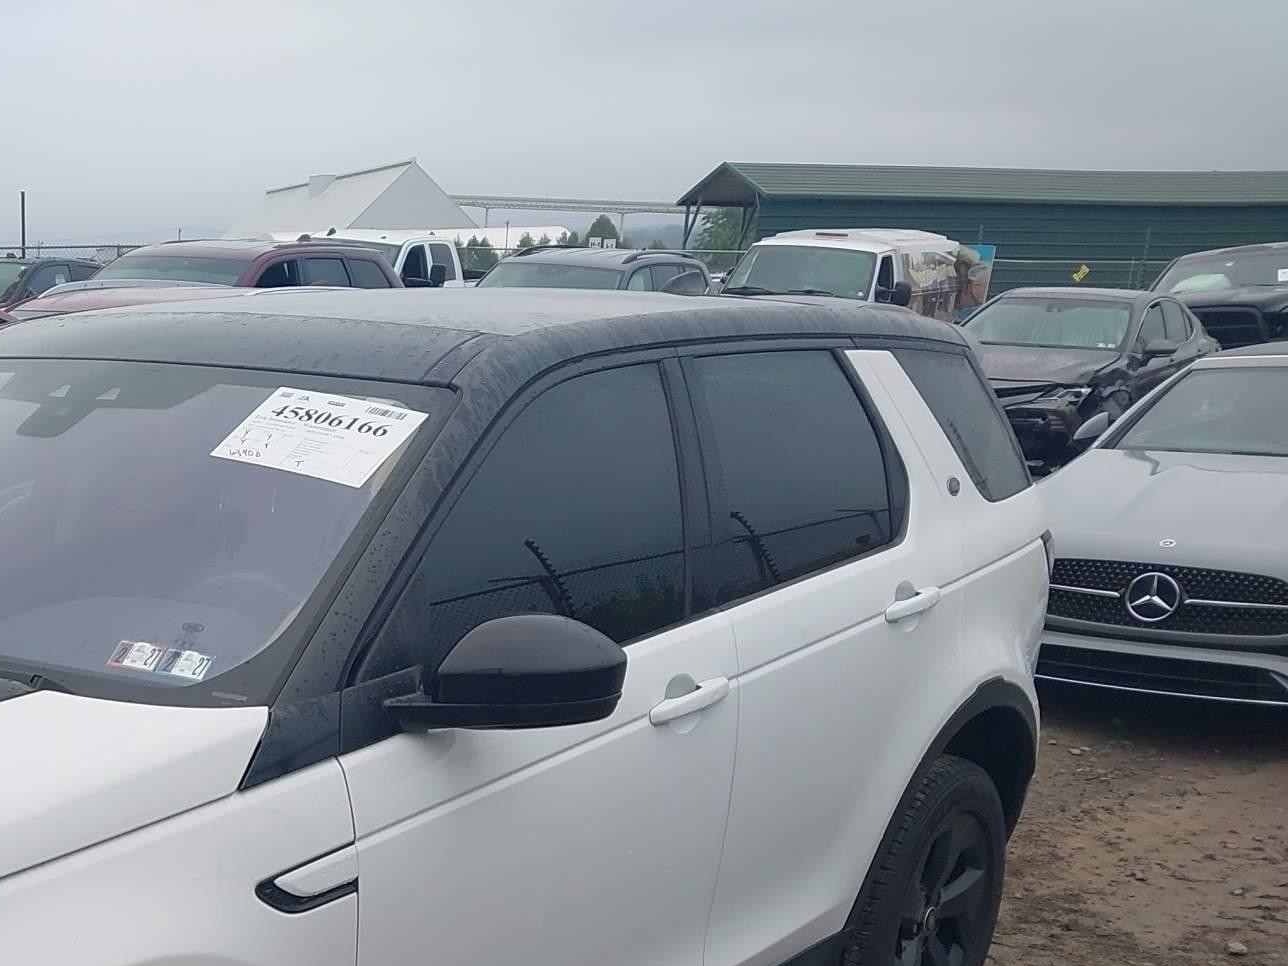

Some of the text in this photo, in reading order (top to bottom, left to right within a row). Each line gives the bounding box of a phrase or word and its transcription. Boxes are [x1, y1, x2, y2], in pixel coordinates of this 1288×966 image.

[271, 405, 394, 438] 45806166
[143, 648, 163, 668] 27
[192, 657, 211, 677] 27
